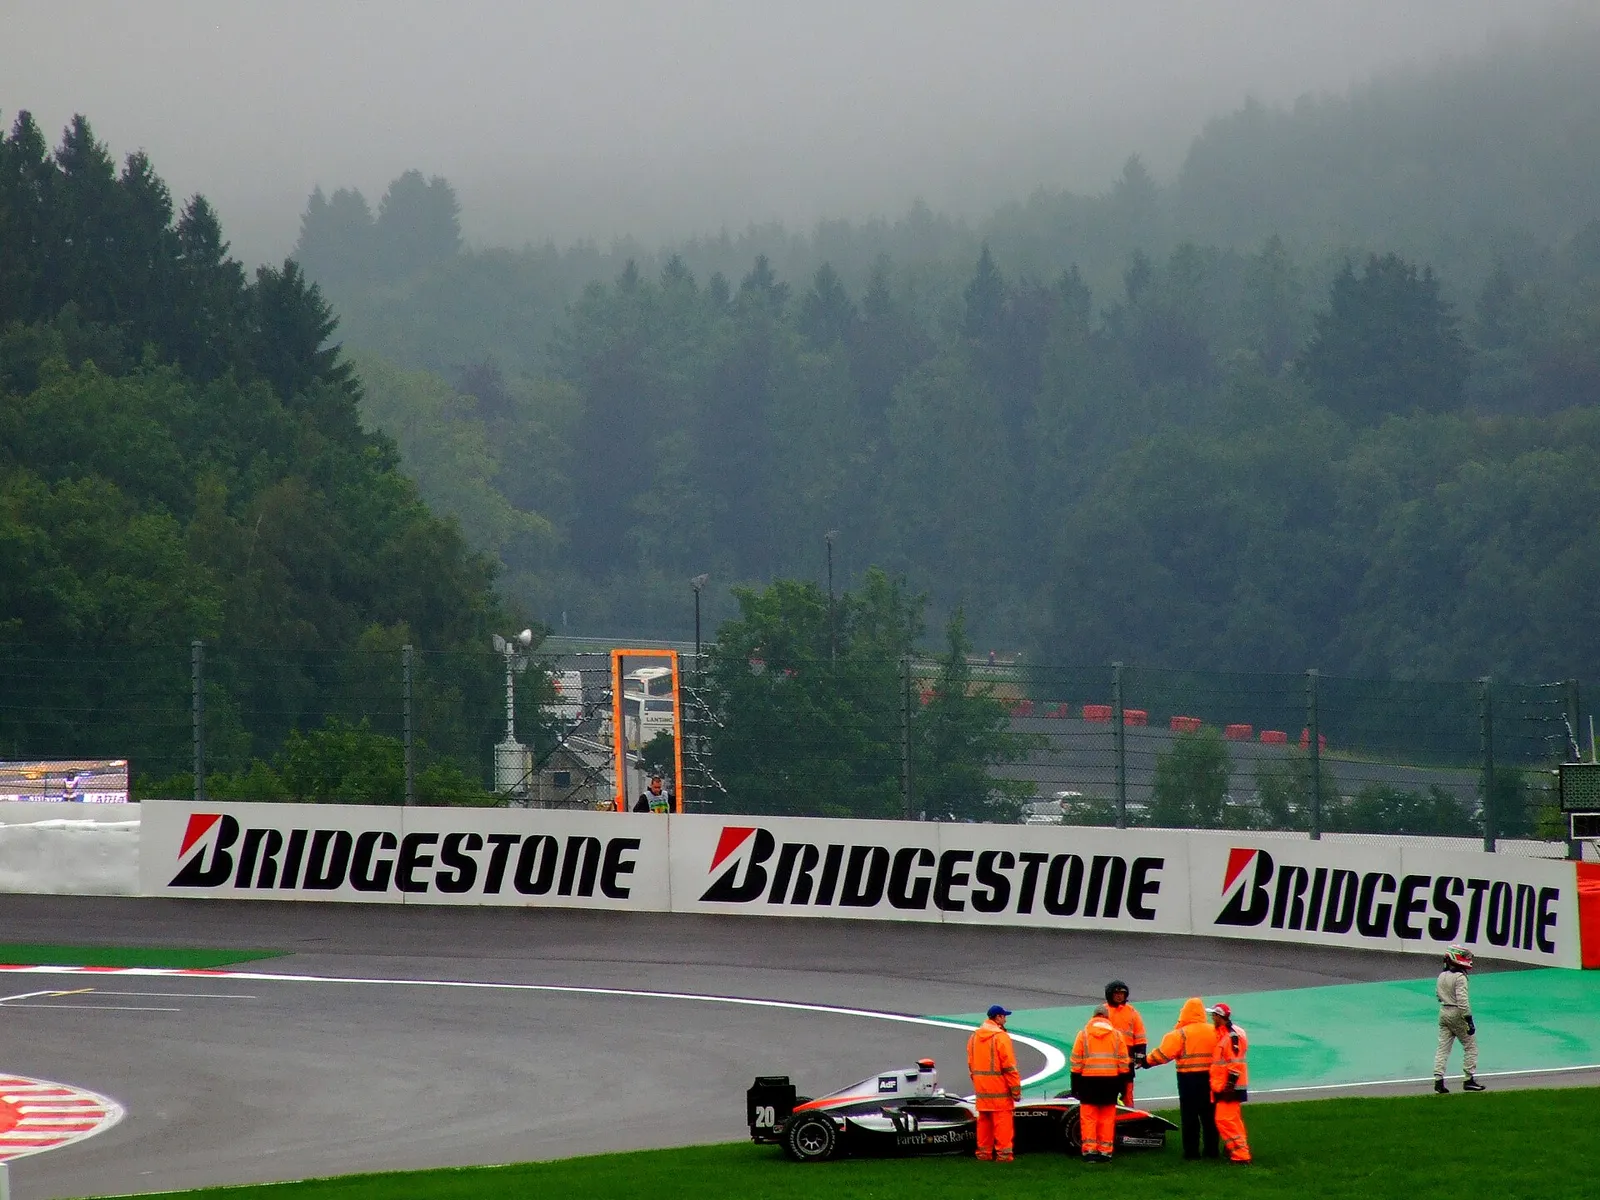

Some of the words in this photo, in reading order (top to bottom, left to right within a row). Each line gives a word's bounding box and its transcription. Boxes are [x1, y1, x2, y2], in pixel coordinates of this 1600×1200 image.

[167, 813, 641, 899] BRIDGESTONE
[697, 826, 1165, 921] BRIDGESTONE
[1213, 848, 1560, 954] BRIDGESTONE
[755, 1105, 776, 1128] 20
